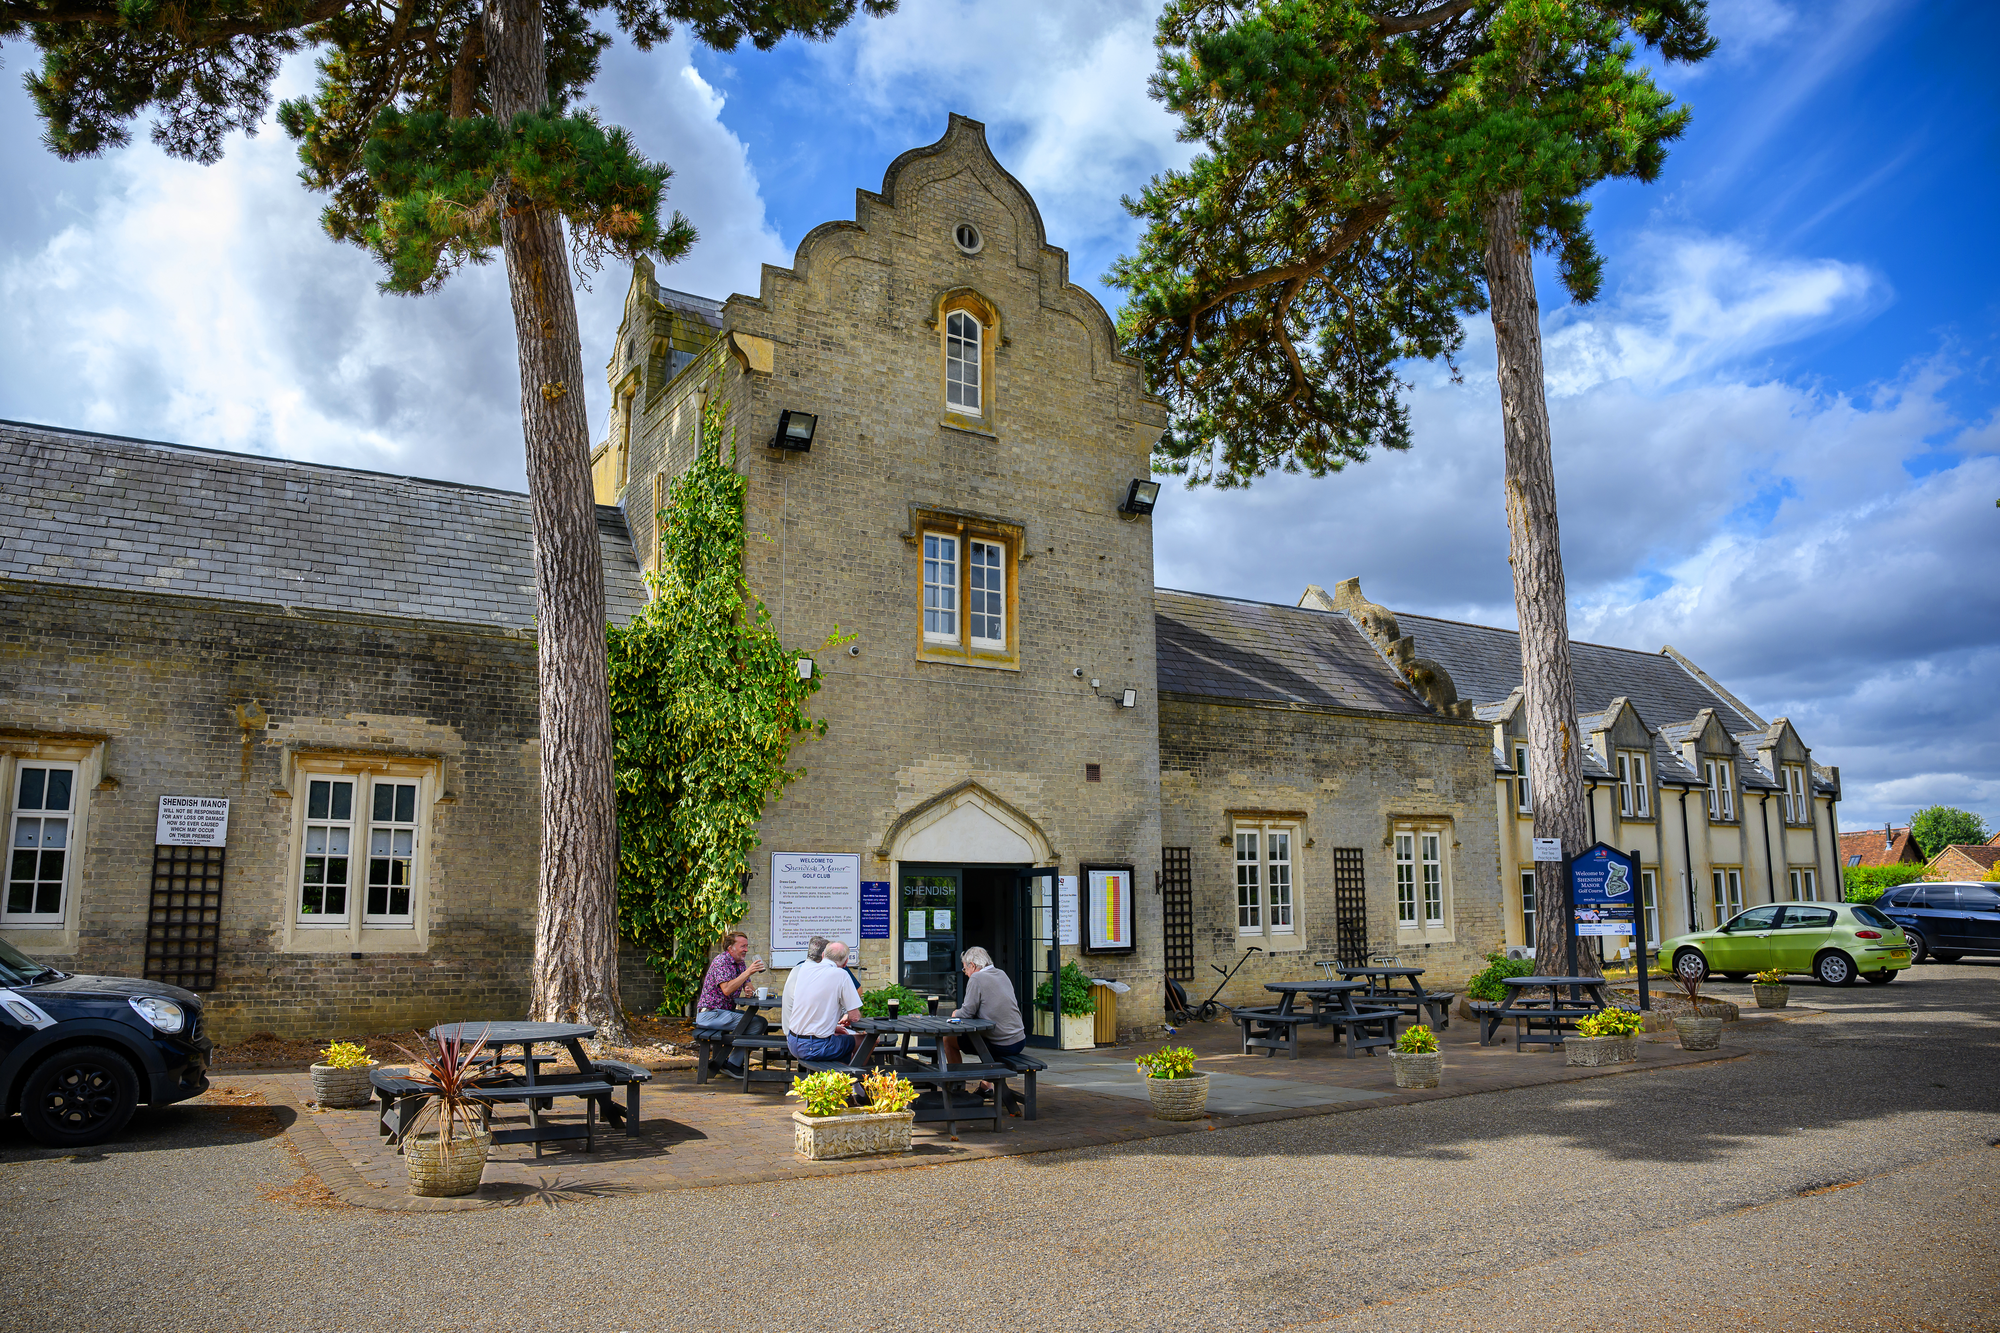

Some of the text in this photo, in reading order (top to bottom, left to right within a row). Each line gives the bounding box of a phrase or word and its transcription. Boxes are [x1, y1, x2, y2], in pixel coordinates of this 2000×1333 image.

[163, 798, 198, 806] SHENDISH
[781, 864, 850, 873] Shendish Manor
[904, 886, 956, 896] SHENDISH
